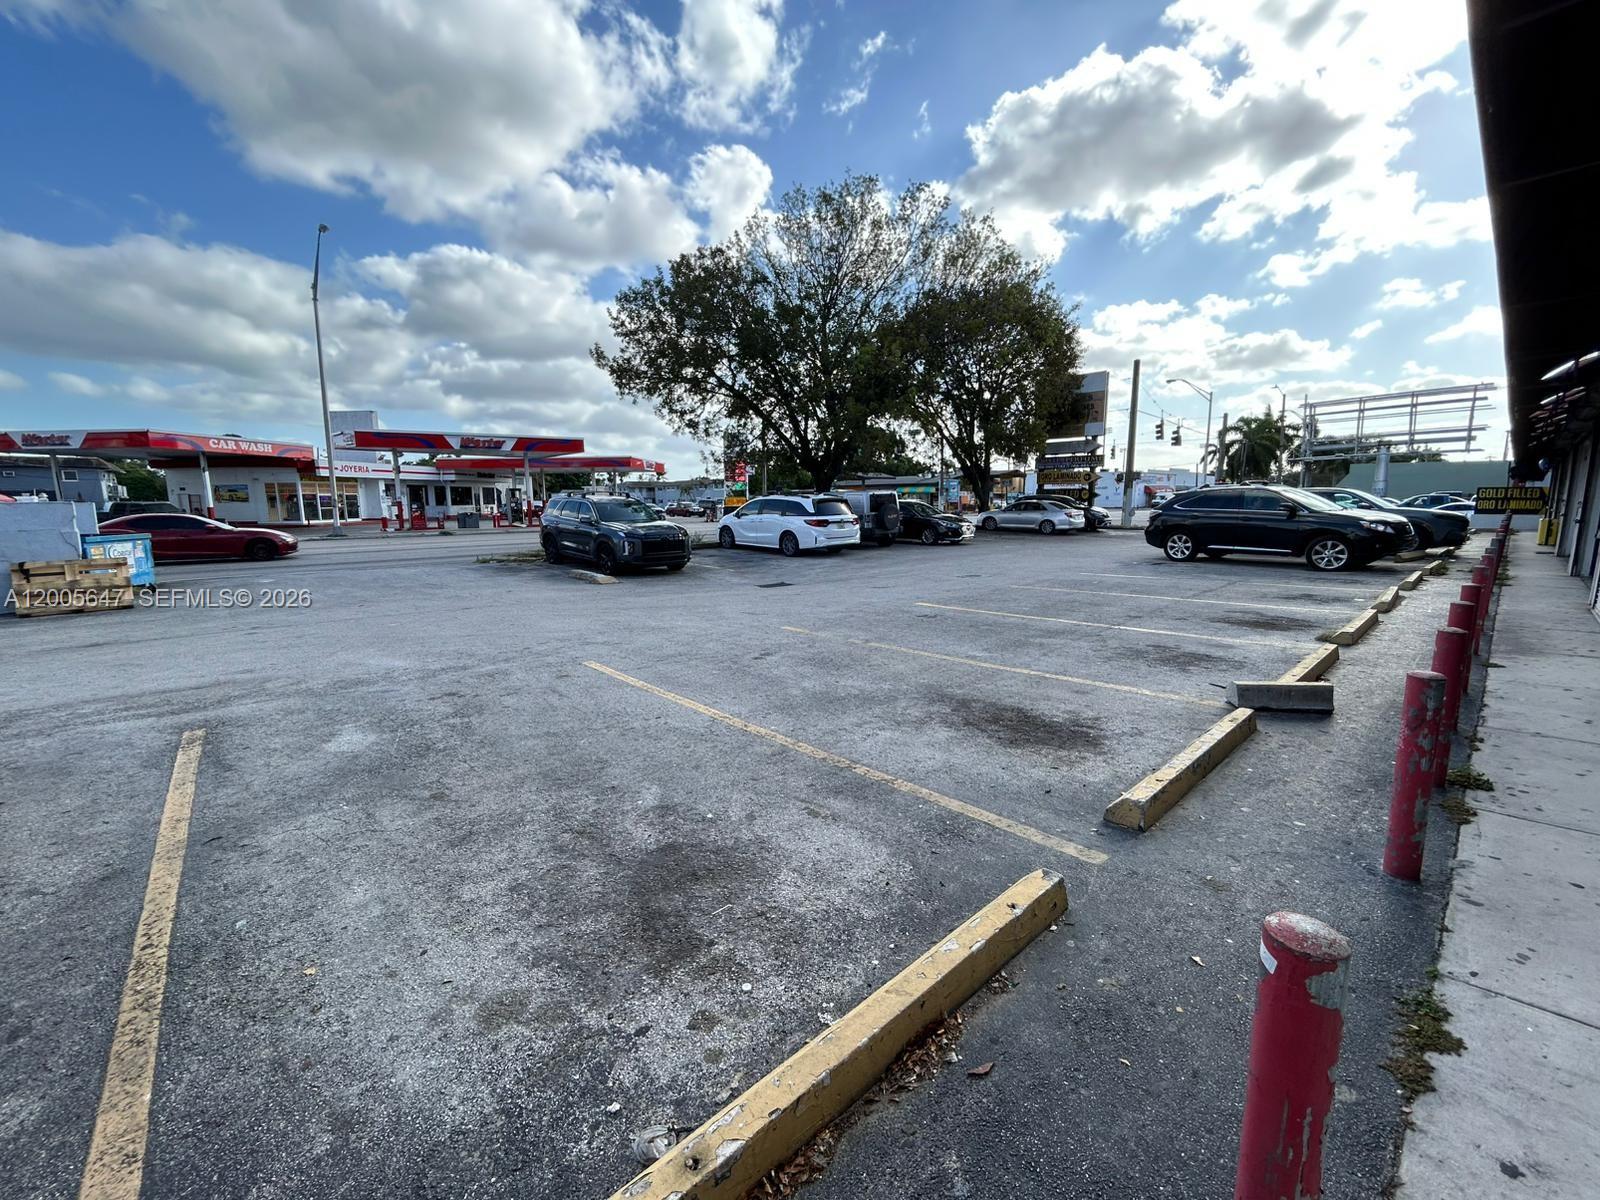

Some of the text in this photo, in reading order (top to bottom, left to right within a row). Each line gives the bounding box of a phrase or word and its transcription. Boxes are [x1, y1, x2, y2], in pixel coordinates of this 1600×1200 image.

[209, 438, 273, 453] CAR WASH
[339, 464, 370, 473] JOYERIA
[1041, 471, 1082, 480] ORO LAMINADO
[1479, 488, 1540, 498] GOLD FILLED
[1477, 499, 1543, 510] ORO LAMINADO
